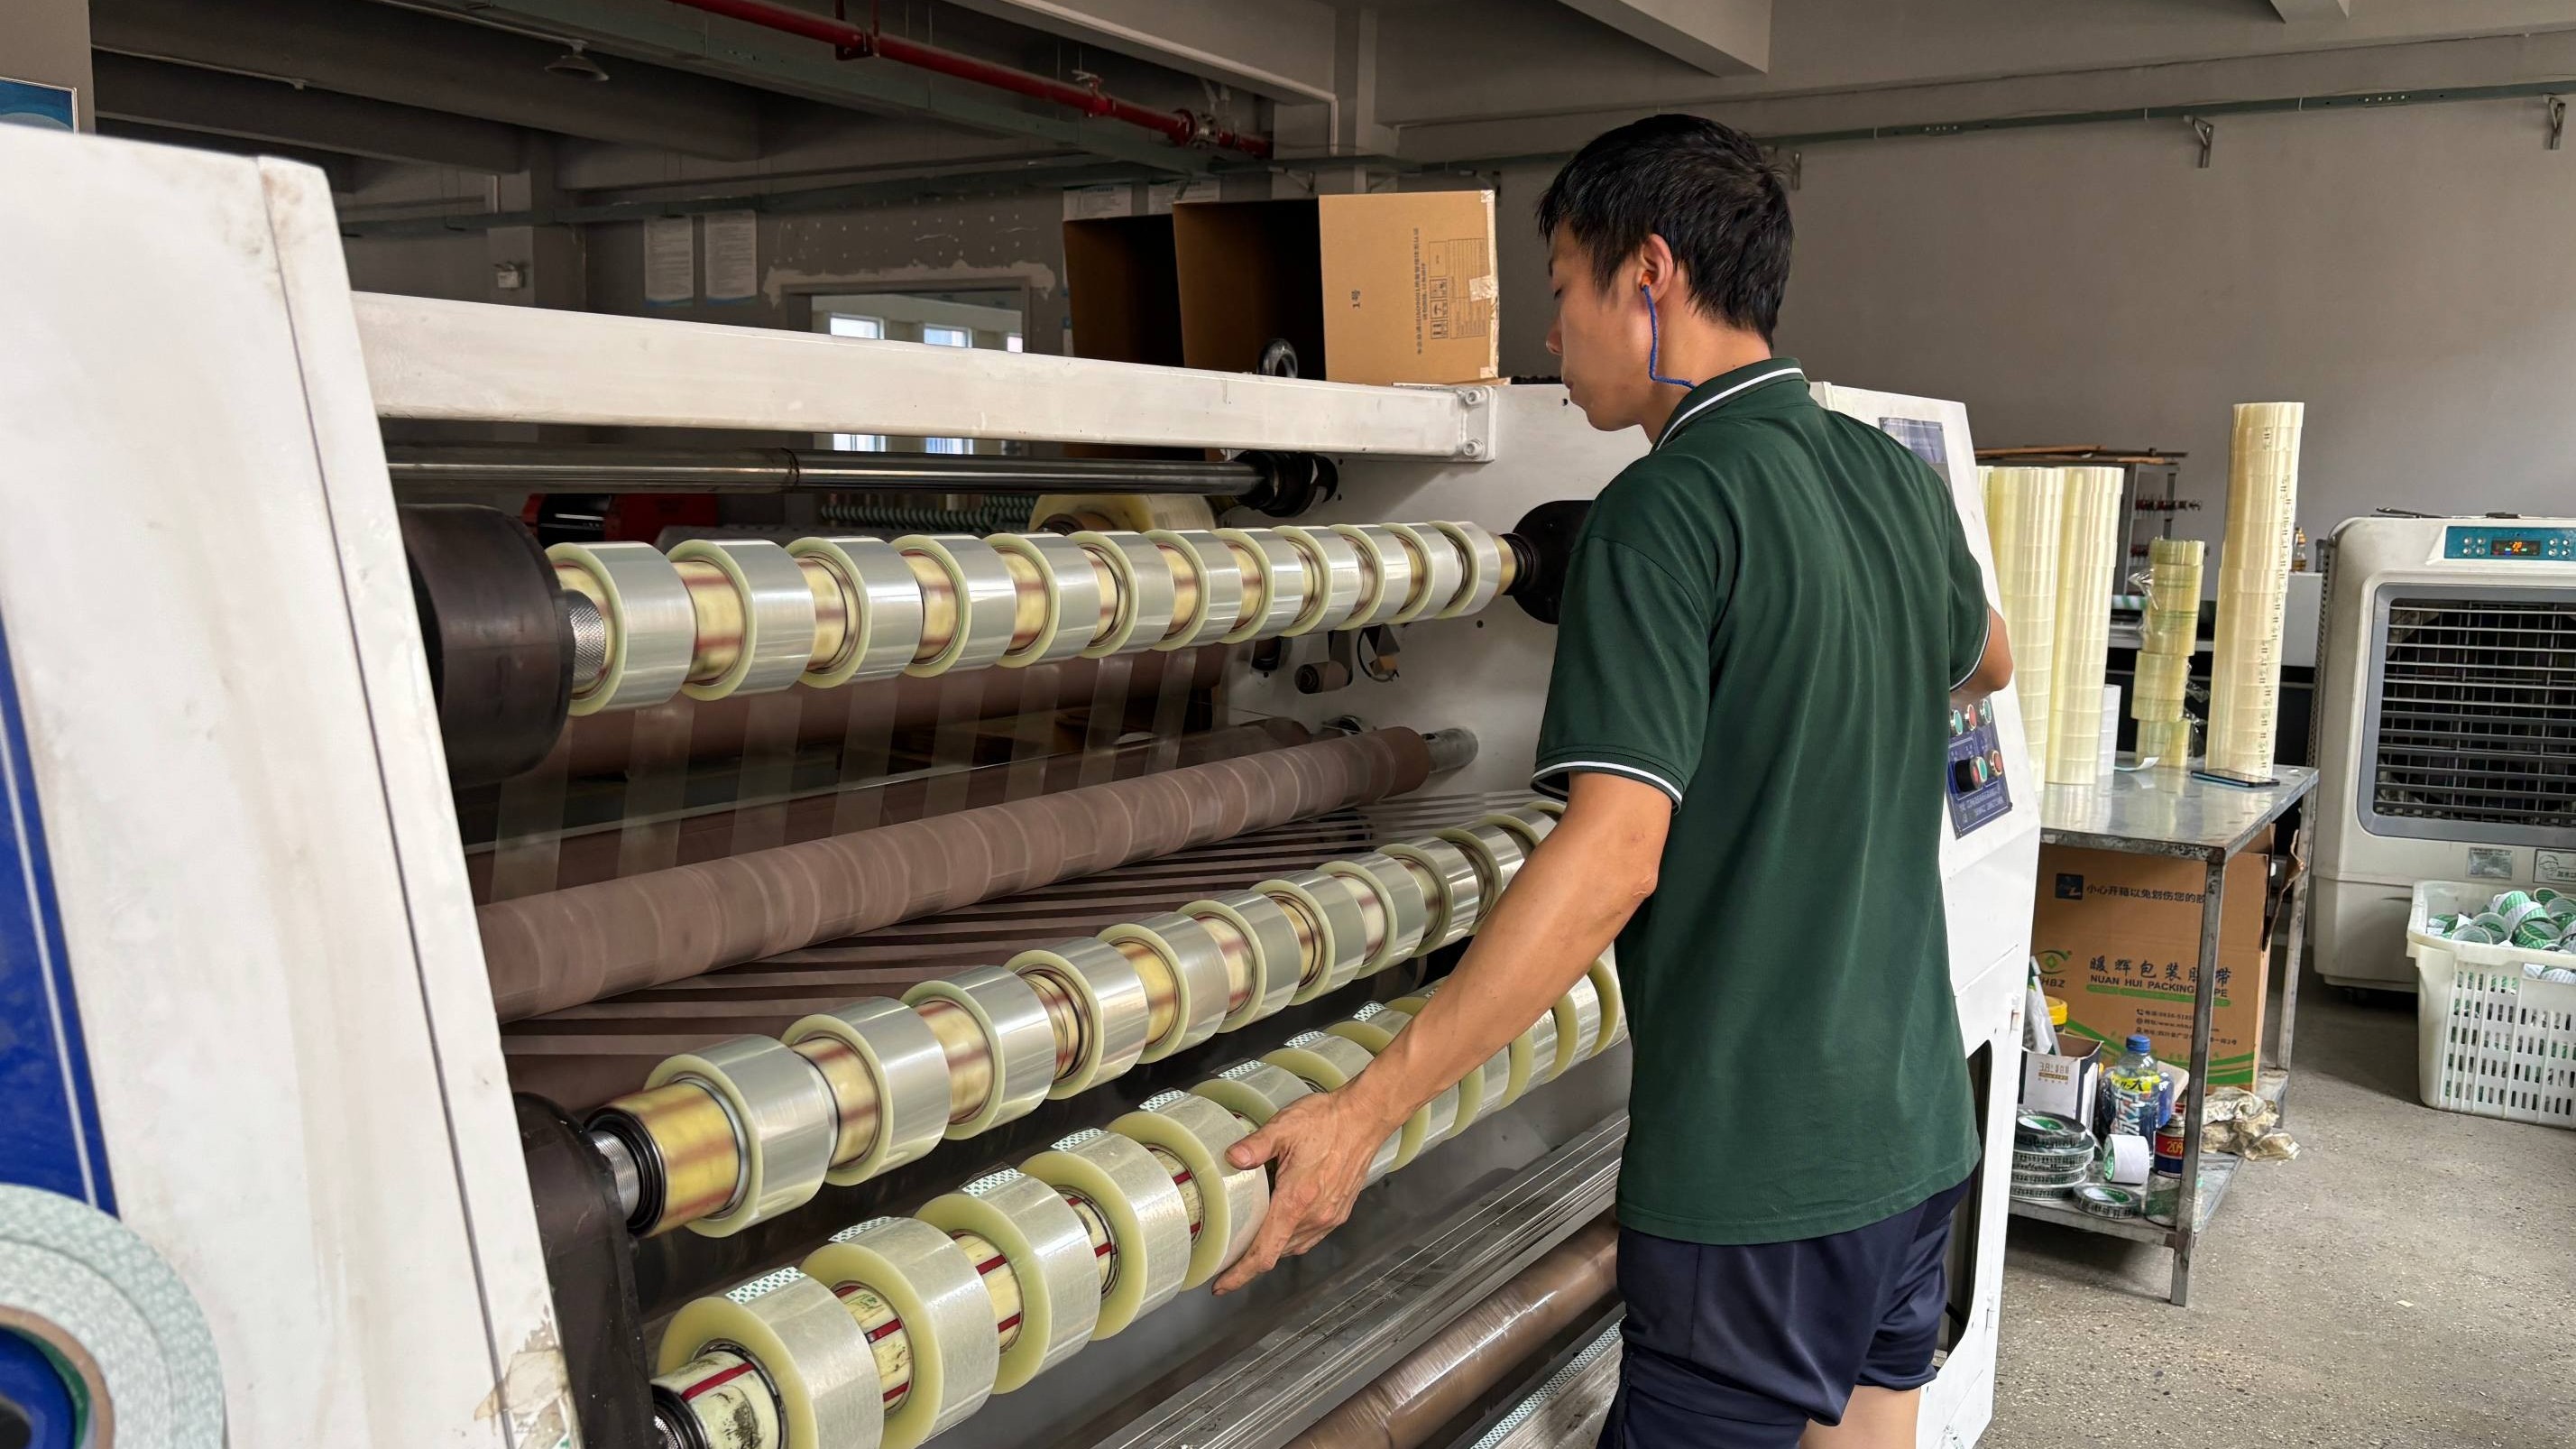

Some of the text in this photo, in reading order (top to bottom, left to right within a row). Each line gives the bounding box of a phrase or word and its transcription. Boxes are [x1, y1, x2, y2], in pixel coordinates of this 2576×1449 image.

[2040, 976, 2066, 989] HBZ
[2091, 974, 2120, 985] NUAN
[2124, 978, 2142, 988] HUI
[2148, 981, 2194, 993] PACKING
